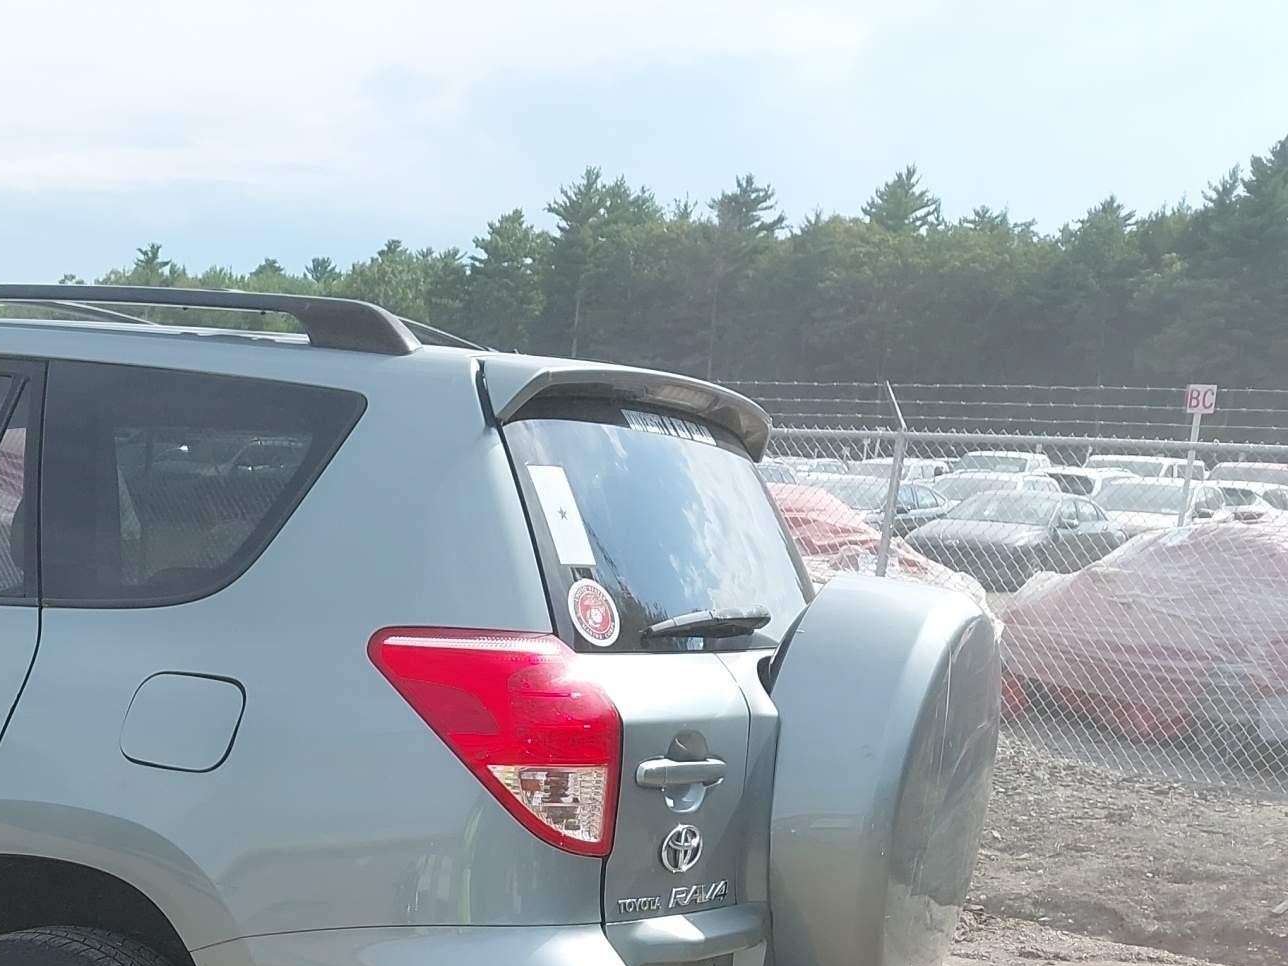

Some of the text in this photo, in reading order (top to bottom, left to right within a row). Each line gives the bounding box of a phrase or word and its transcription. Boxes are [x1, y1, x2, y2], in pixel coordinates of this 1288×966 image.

[1189, 389, 1215, 409] BC
[618, 879, 729, 913] TOYOTA RAV4
